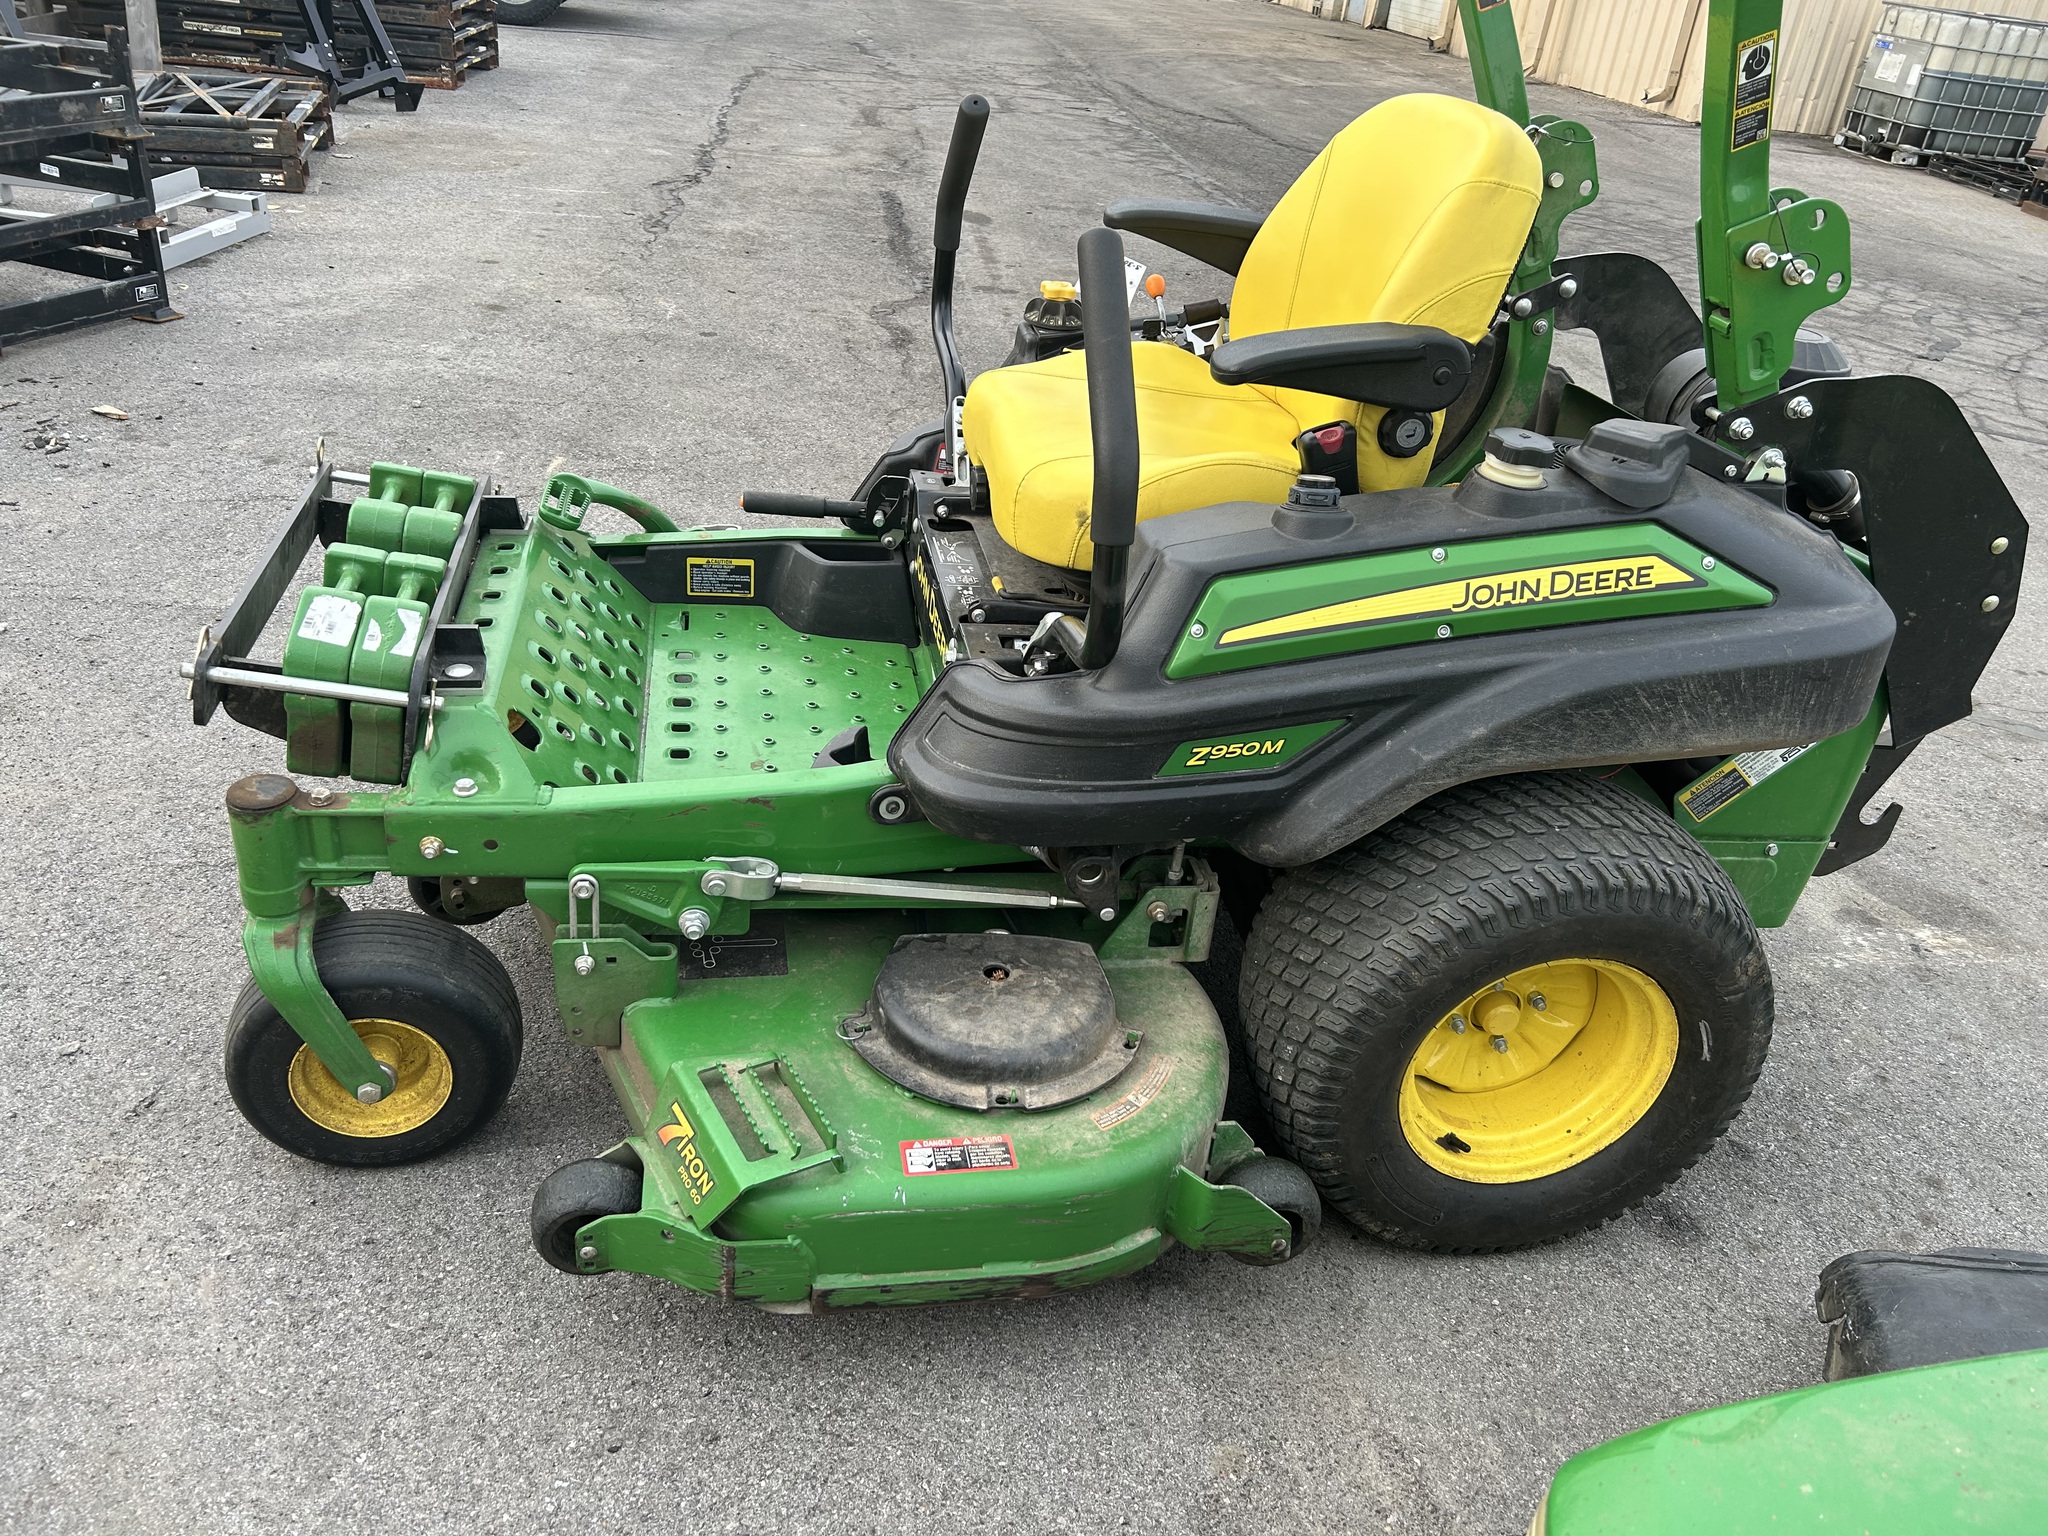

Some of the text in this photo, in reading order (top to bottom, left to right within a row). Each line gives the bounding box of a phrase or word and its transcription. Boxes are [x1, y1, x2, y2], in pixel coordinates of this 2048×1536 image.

[1747, 32, 1775, 47] CAUTION
[1452, 565, 1655, 609] JOHN DEERE
[1184, 738, 1286, 767] Z950M
[1694, 768, 1726, 793] ATENCION
[922, 1139, 953, 1147] DANGER
[972, 1135, 1003, 1144] PELIGRO
[677, 1165, 702, 1205] PRO 60
